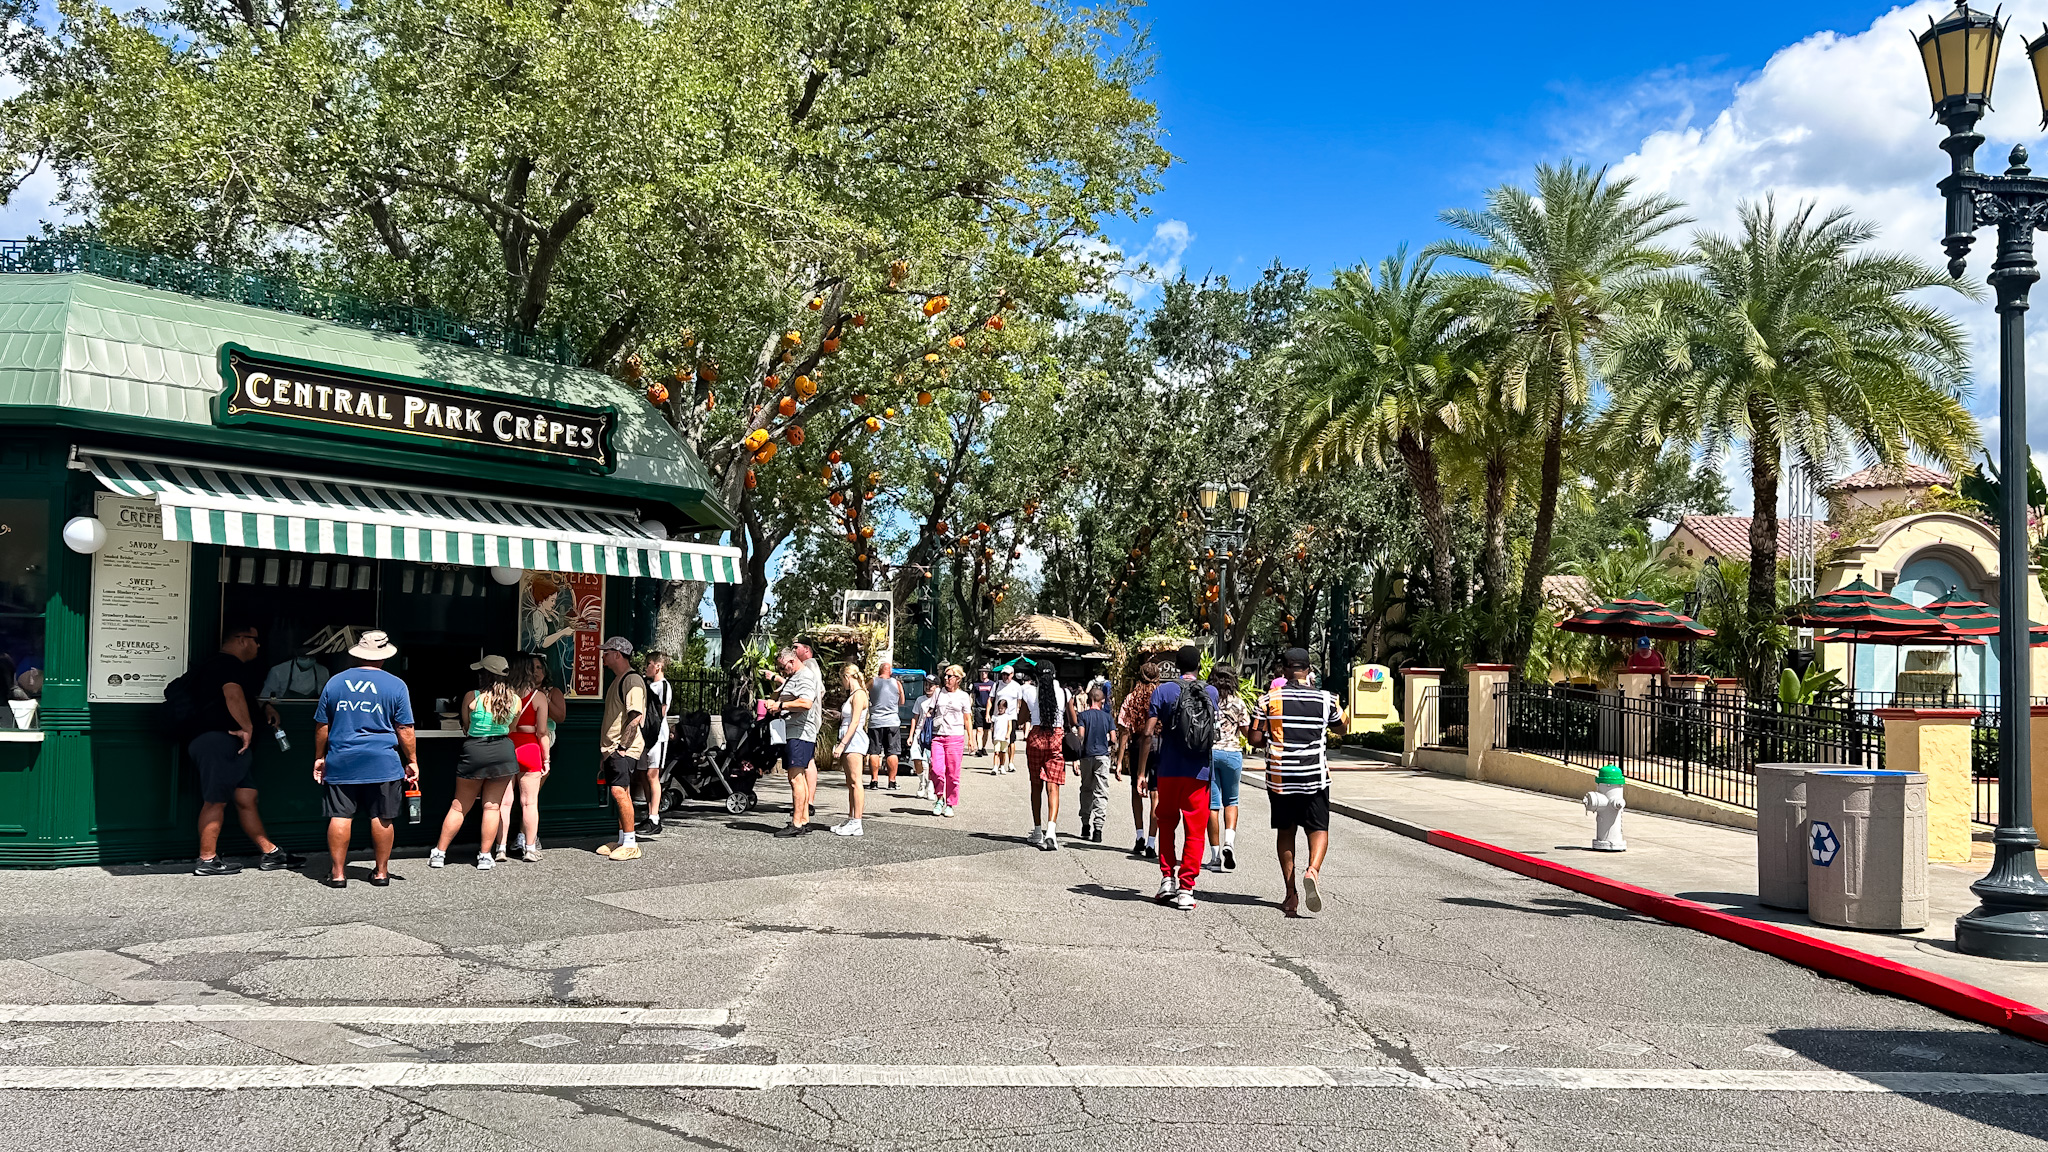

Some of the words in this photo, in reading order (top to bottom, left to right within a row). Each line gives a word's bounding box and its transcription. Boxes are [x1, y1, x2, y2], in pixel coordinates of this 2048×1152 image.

[244, 371, 392, 421] CENTRAL
[403, 395, 482, 434] PARK
[493, 411, 595, 450] CRÊPES
[129, 541, 158, 549] SAVORY
[129, 578, 154, 586] SWEET
[116, 641, 159, 649] BEVERAGES
[336, 700, 384, 715] RVCA
